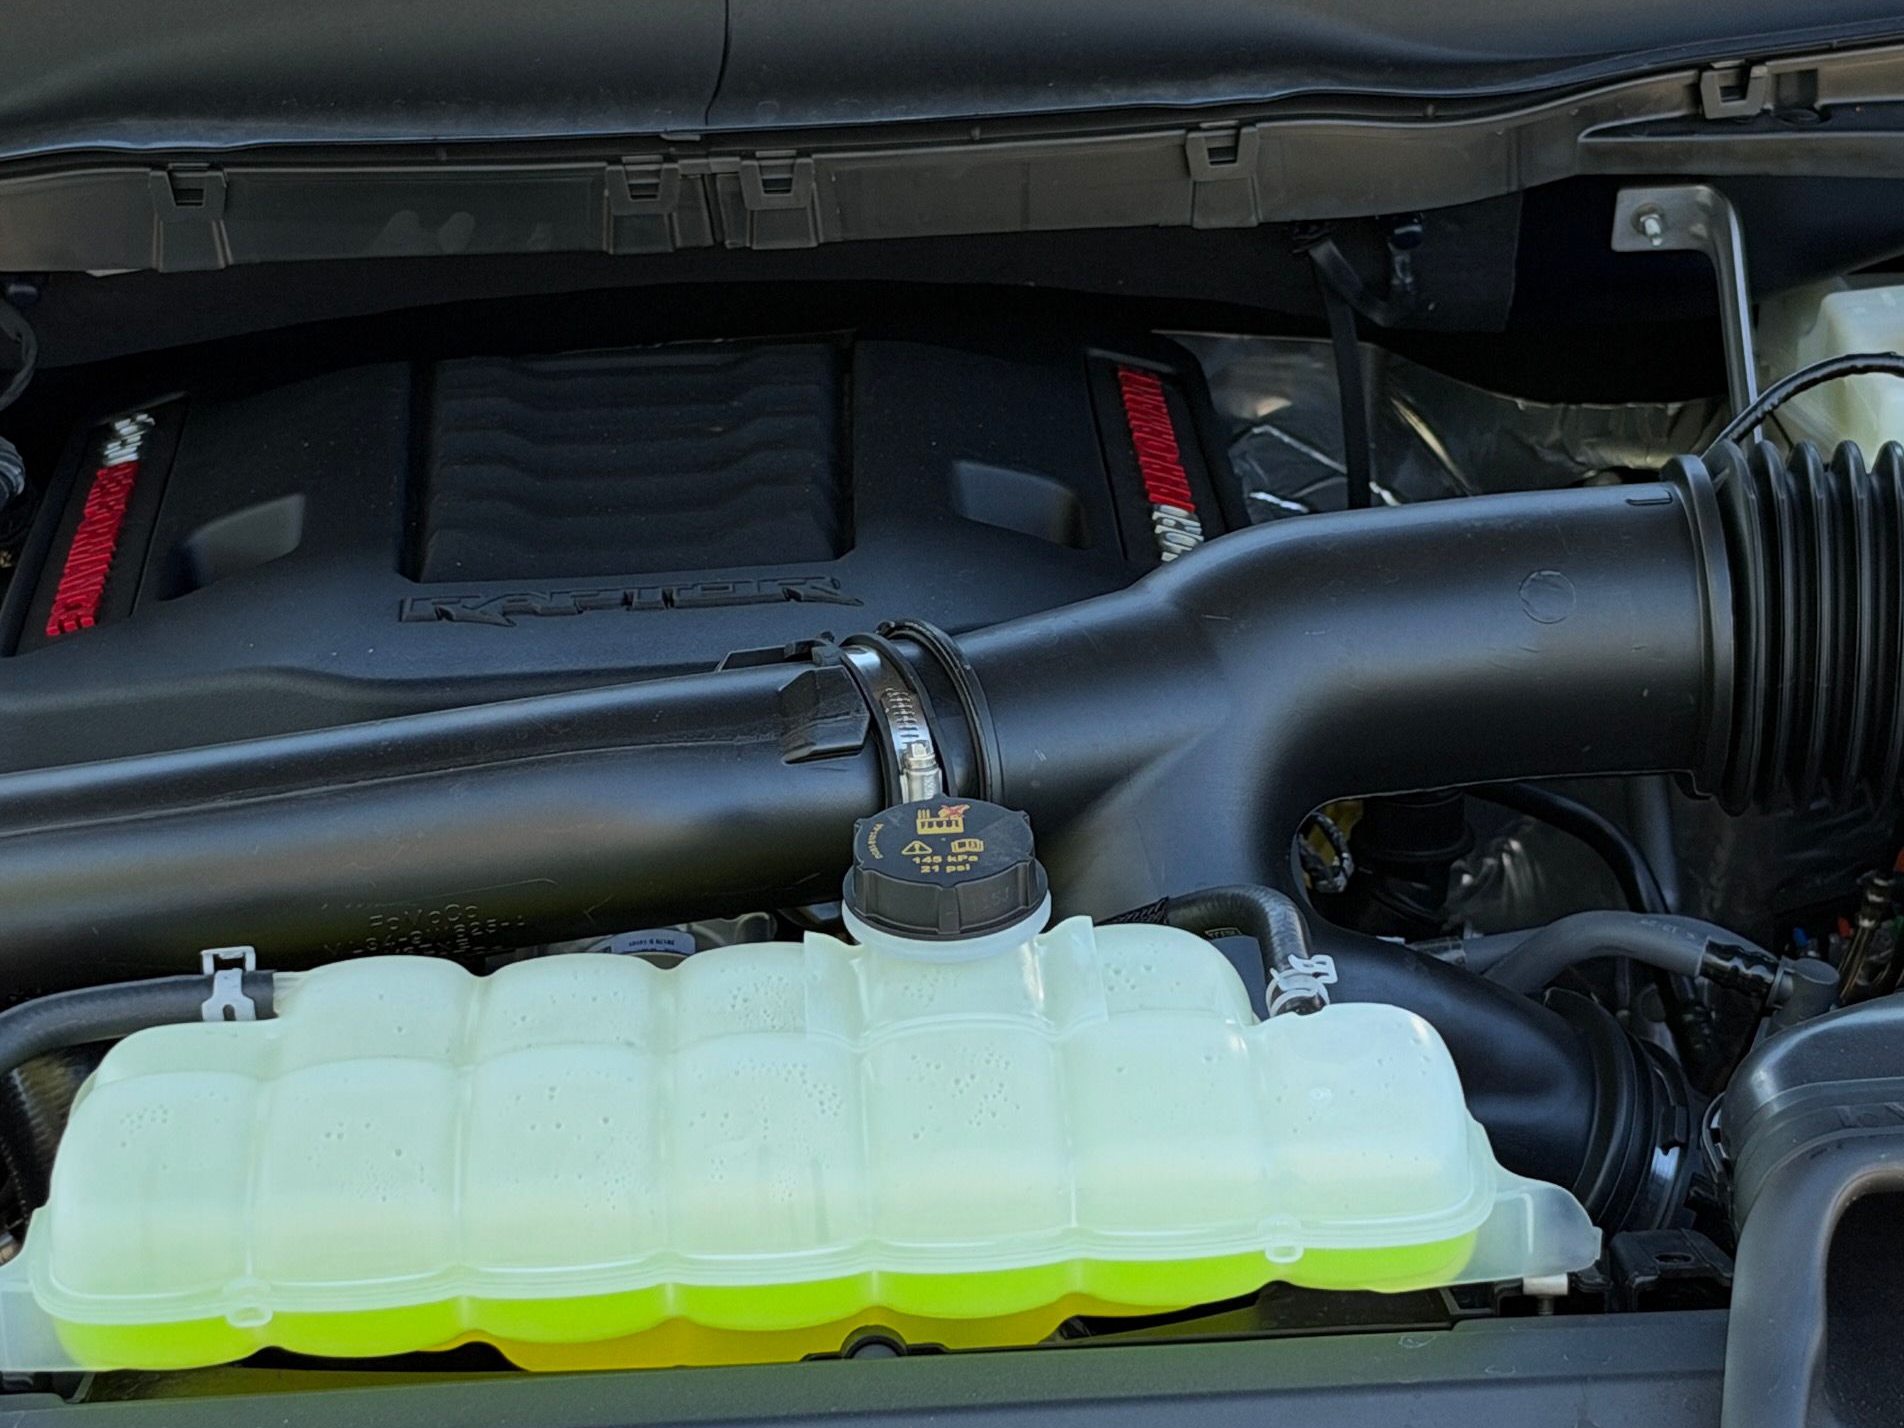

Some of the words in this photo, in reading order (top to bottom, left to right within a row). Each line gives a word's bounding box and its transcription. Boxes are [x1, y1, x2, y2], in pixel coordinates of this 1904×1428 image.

[398, 576, 864, 628] RAPTOR
[912, 855, 943, 864] 145
[947, 854, 979, 863] kPa
[920, 864, 939, 873] 21
[946, 863, 971, 873] psi
